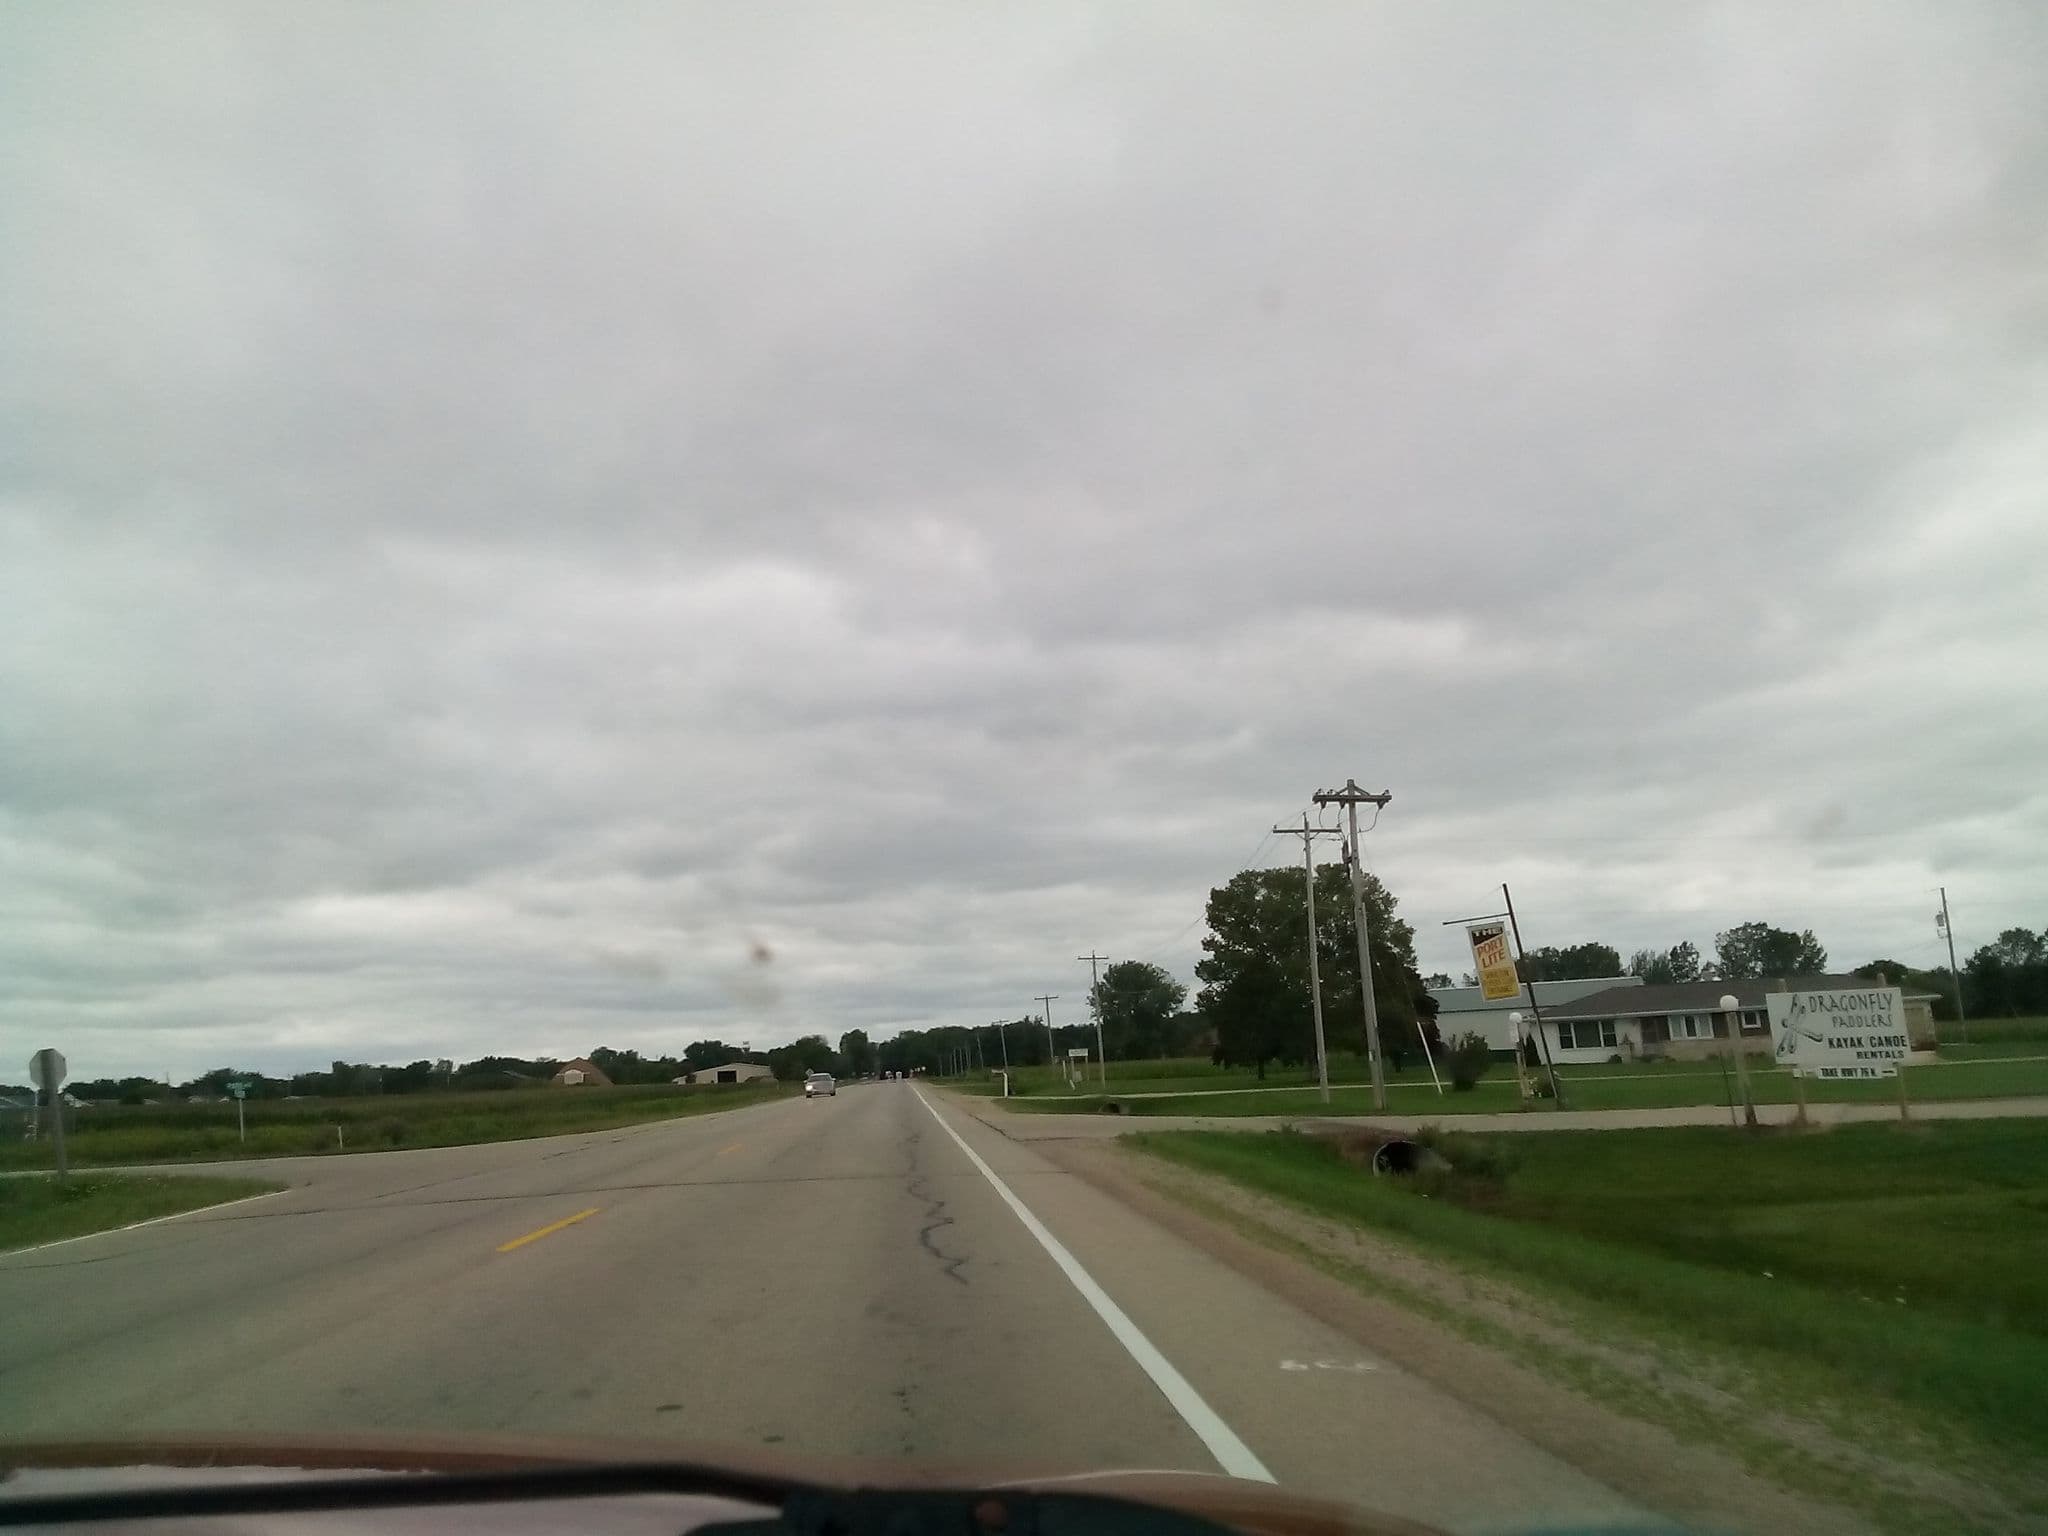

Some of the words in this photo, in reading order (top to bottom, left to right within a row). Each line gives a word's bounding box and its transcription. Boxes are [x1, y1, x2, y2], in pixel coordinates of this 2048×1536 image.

[1809, 993, 1893, 1013] DRAGONFLY
[1832, 1015, 1892, 1028] PADDLERS
[1829, 1037, 1865, 1049] KAYAK
[1870, 1036, 1908, 1048] CANOE
[1857, 1051, 1904, 1059] RENTALS
